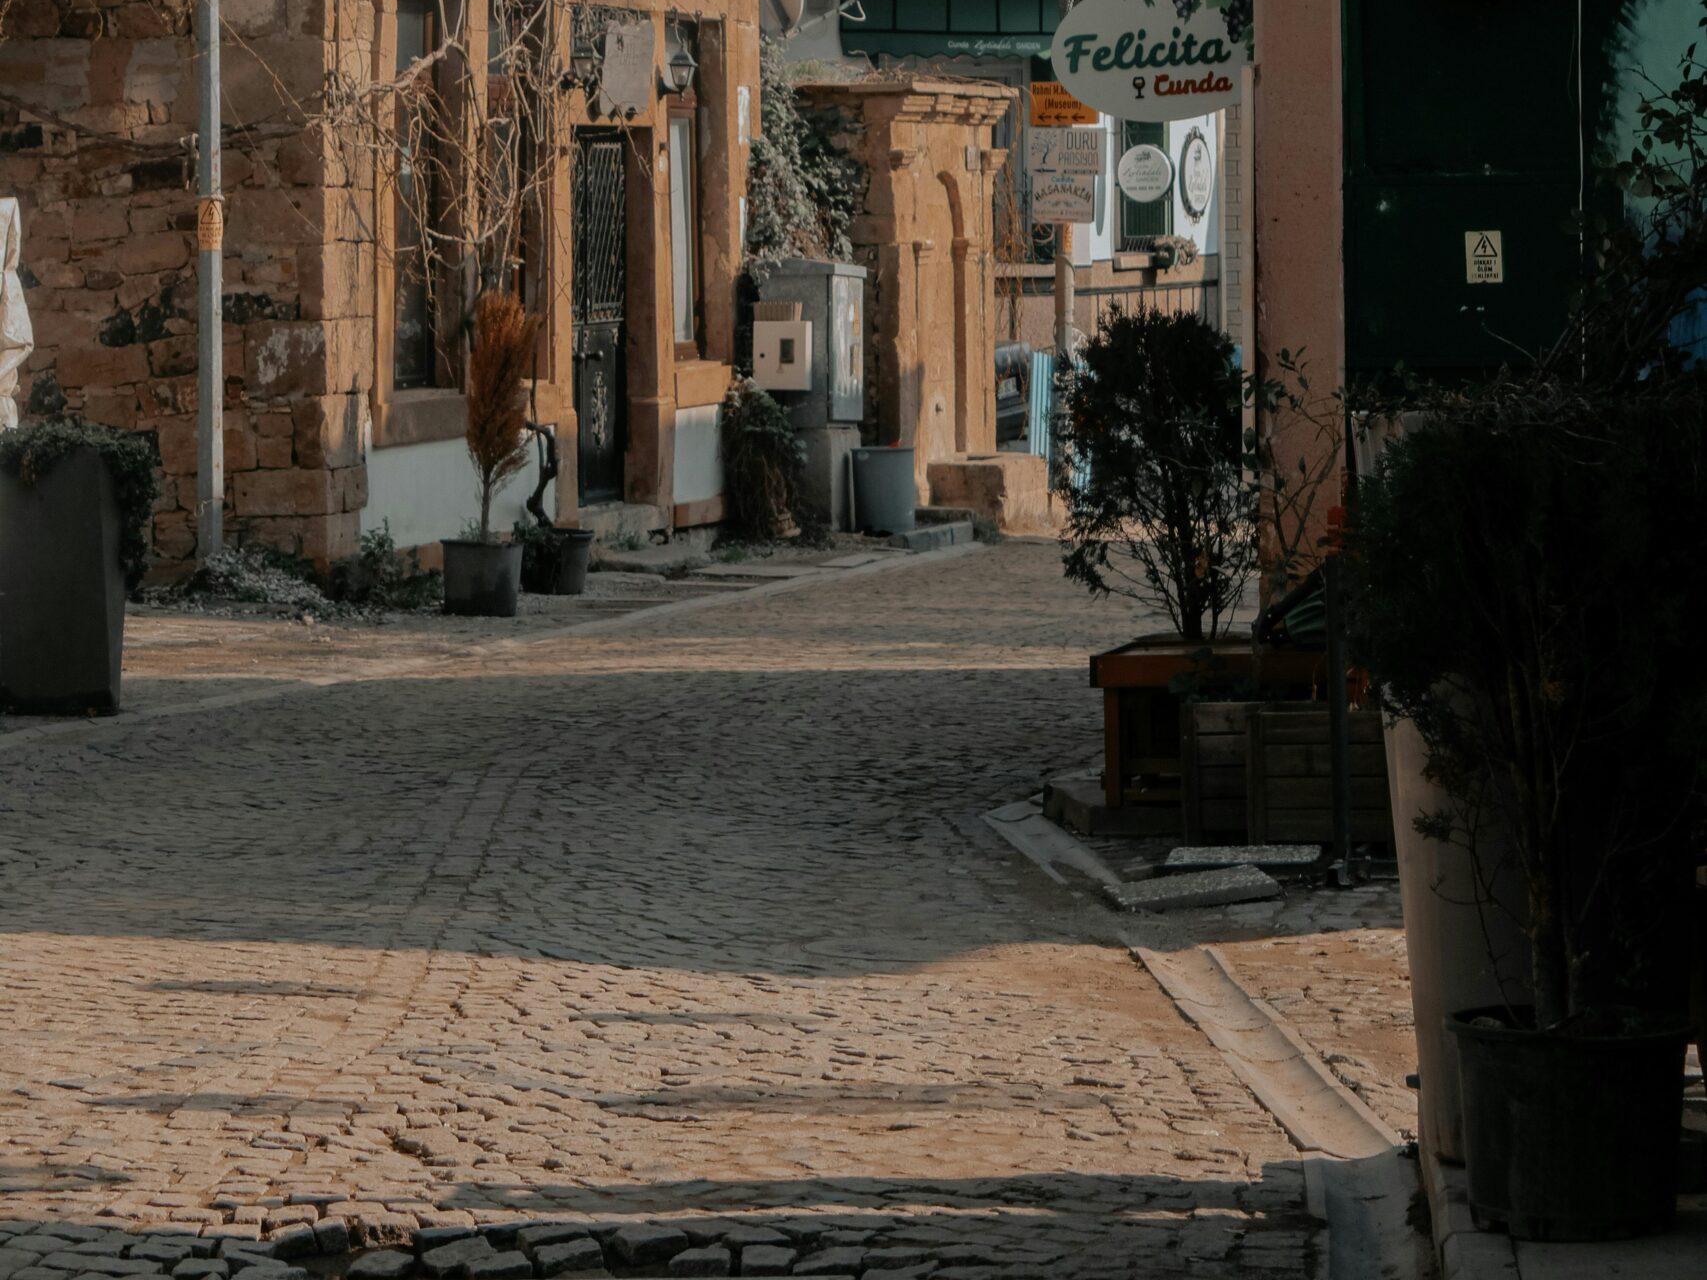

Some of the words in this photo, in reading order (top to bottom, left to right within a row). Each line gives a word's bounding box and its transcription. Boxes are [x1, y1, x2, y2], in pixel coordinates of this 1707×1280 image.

[1063, 26, 1232, 74] Felicita
[1153, 70, 1234, 97] Cunda
[1066, 131, 1098, 150] DURU
